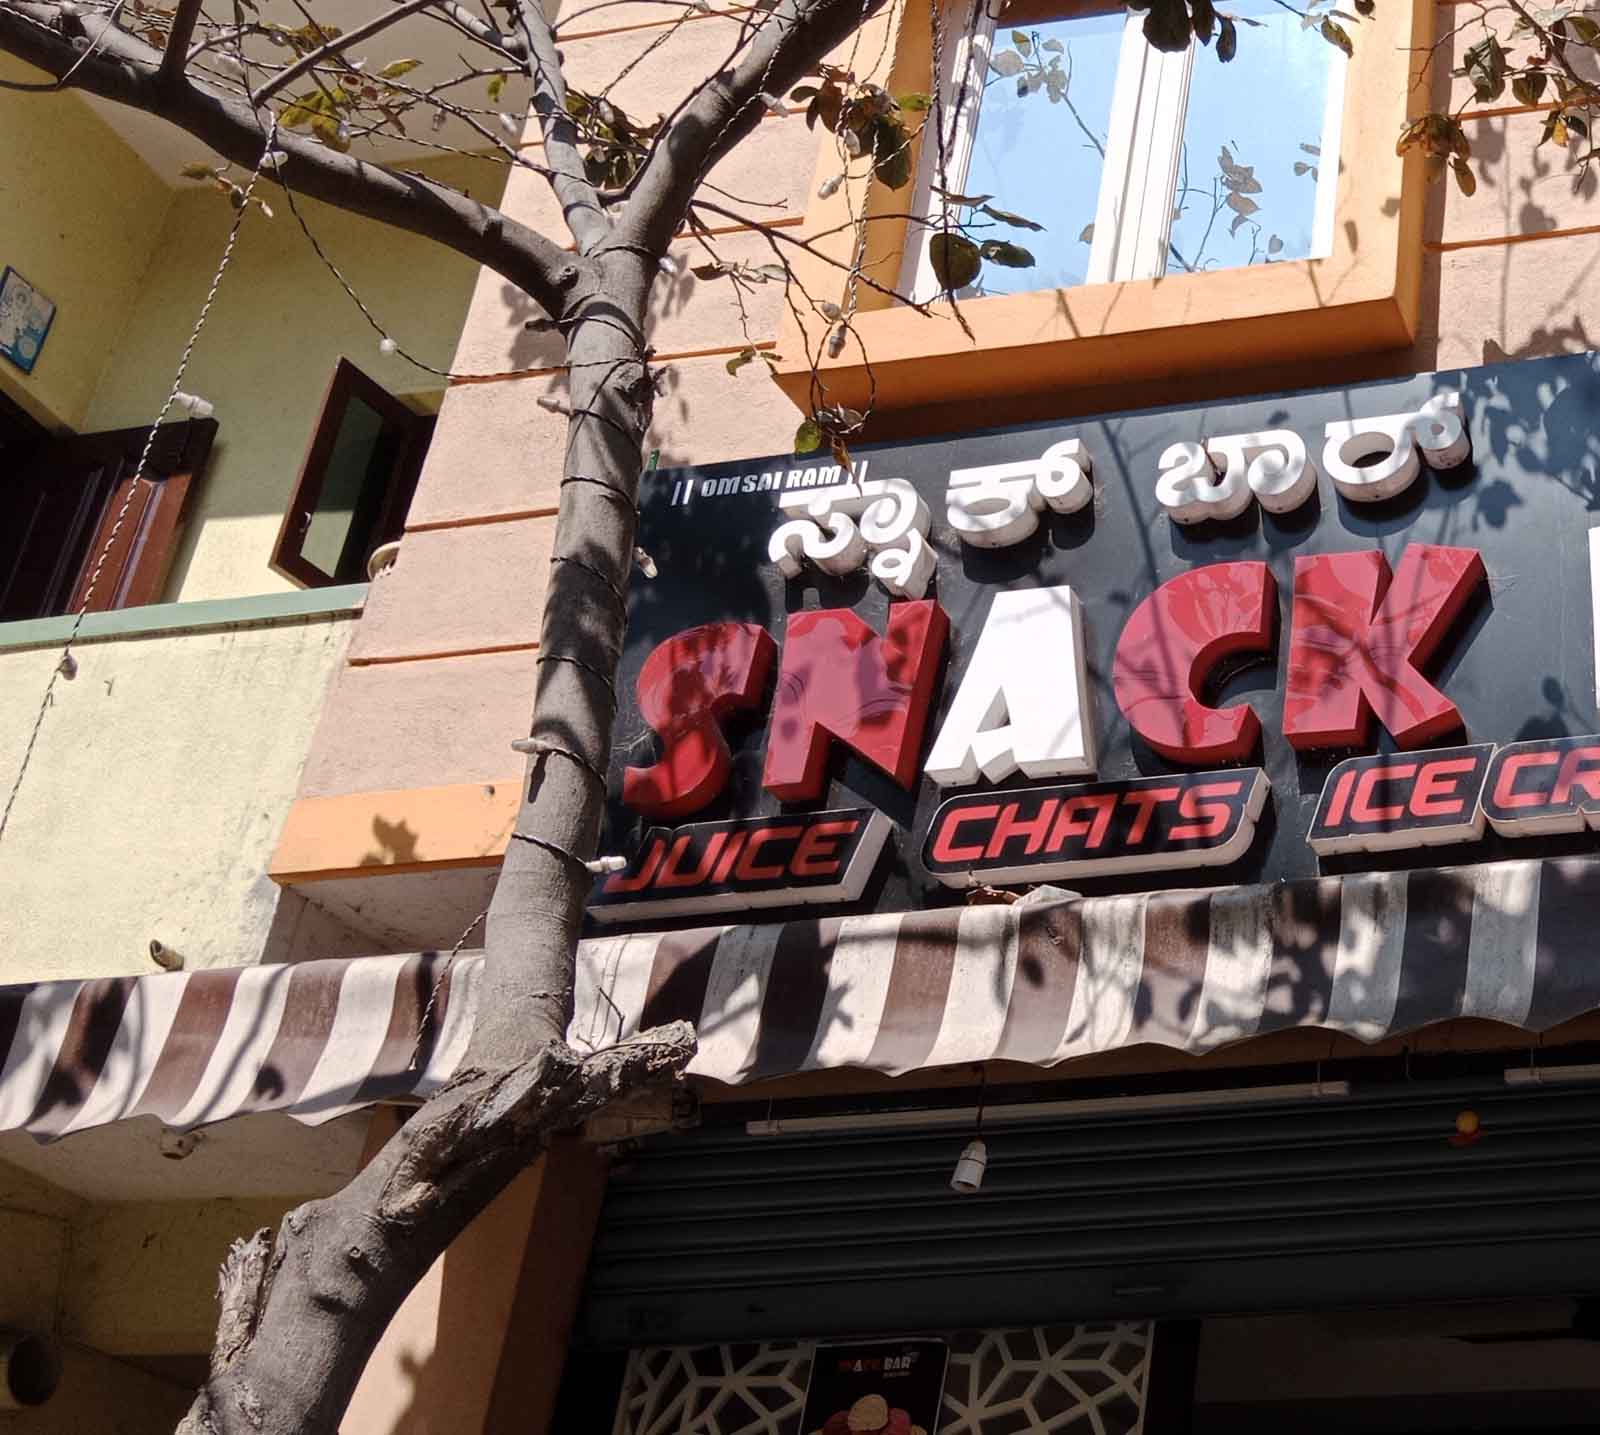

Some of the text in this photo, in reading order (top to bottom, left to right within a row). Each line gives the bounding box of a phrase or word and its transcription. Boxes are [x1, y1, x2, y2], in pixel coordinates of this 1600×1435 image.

[785, 464, 841, 488] RAM
[1155, 392, 1473, 524] ಬಾರ್
[622, 543, 1490, 817] SNACK
[932, 782, 1243, 863] CHATS
[1324, 758, 1477, 827] ICE
[602, 822, 858, 893] JUICE
